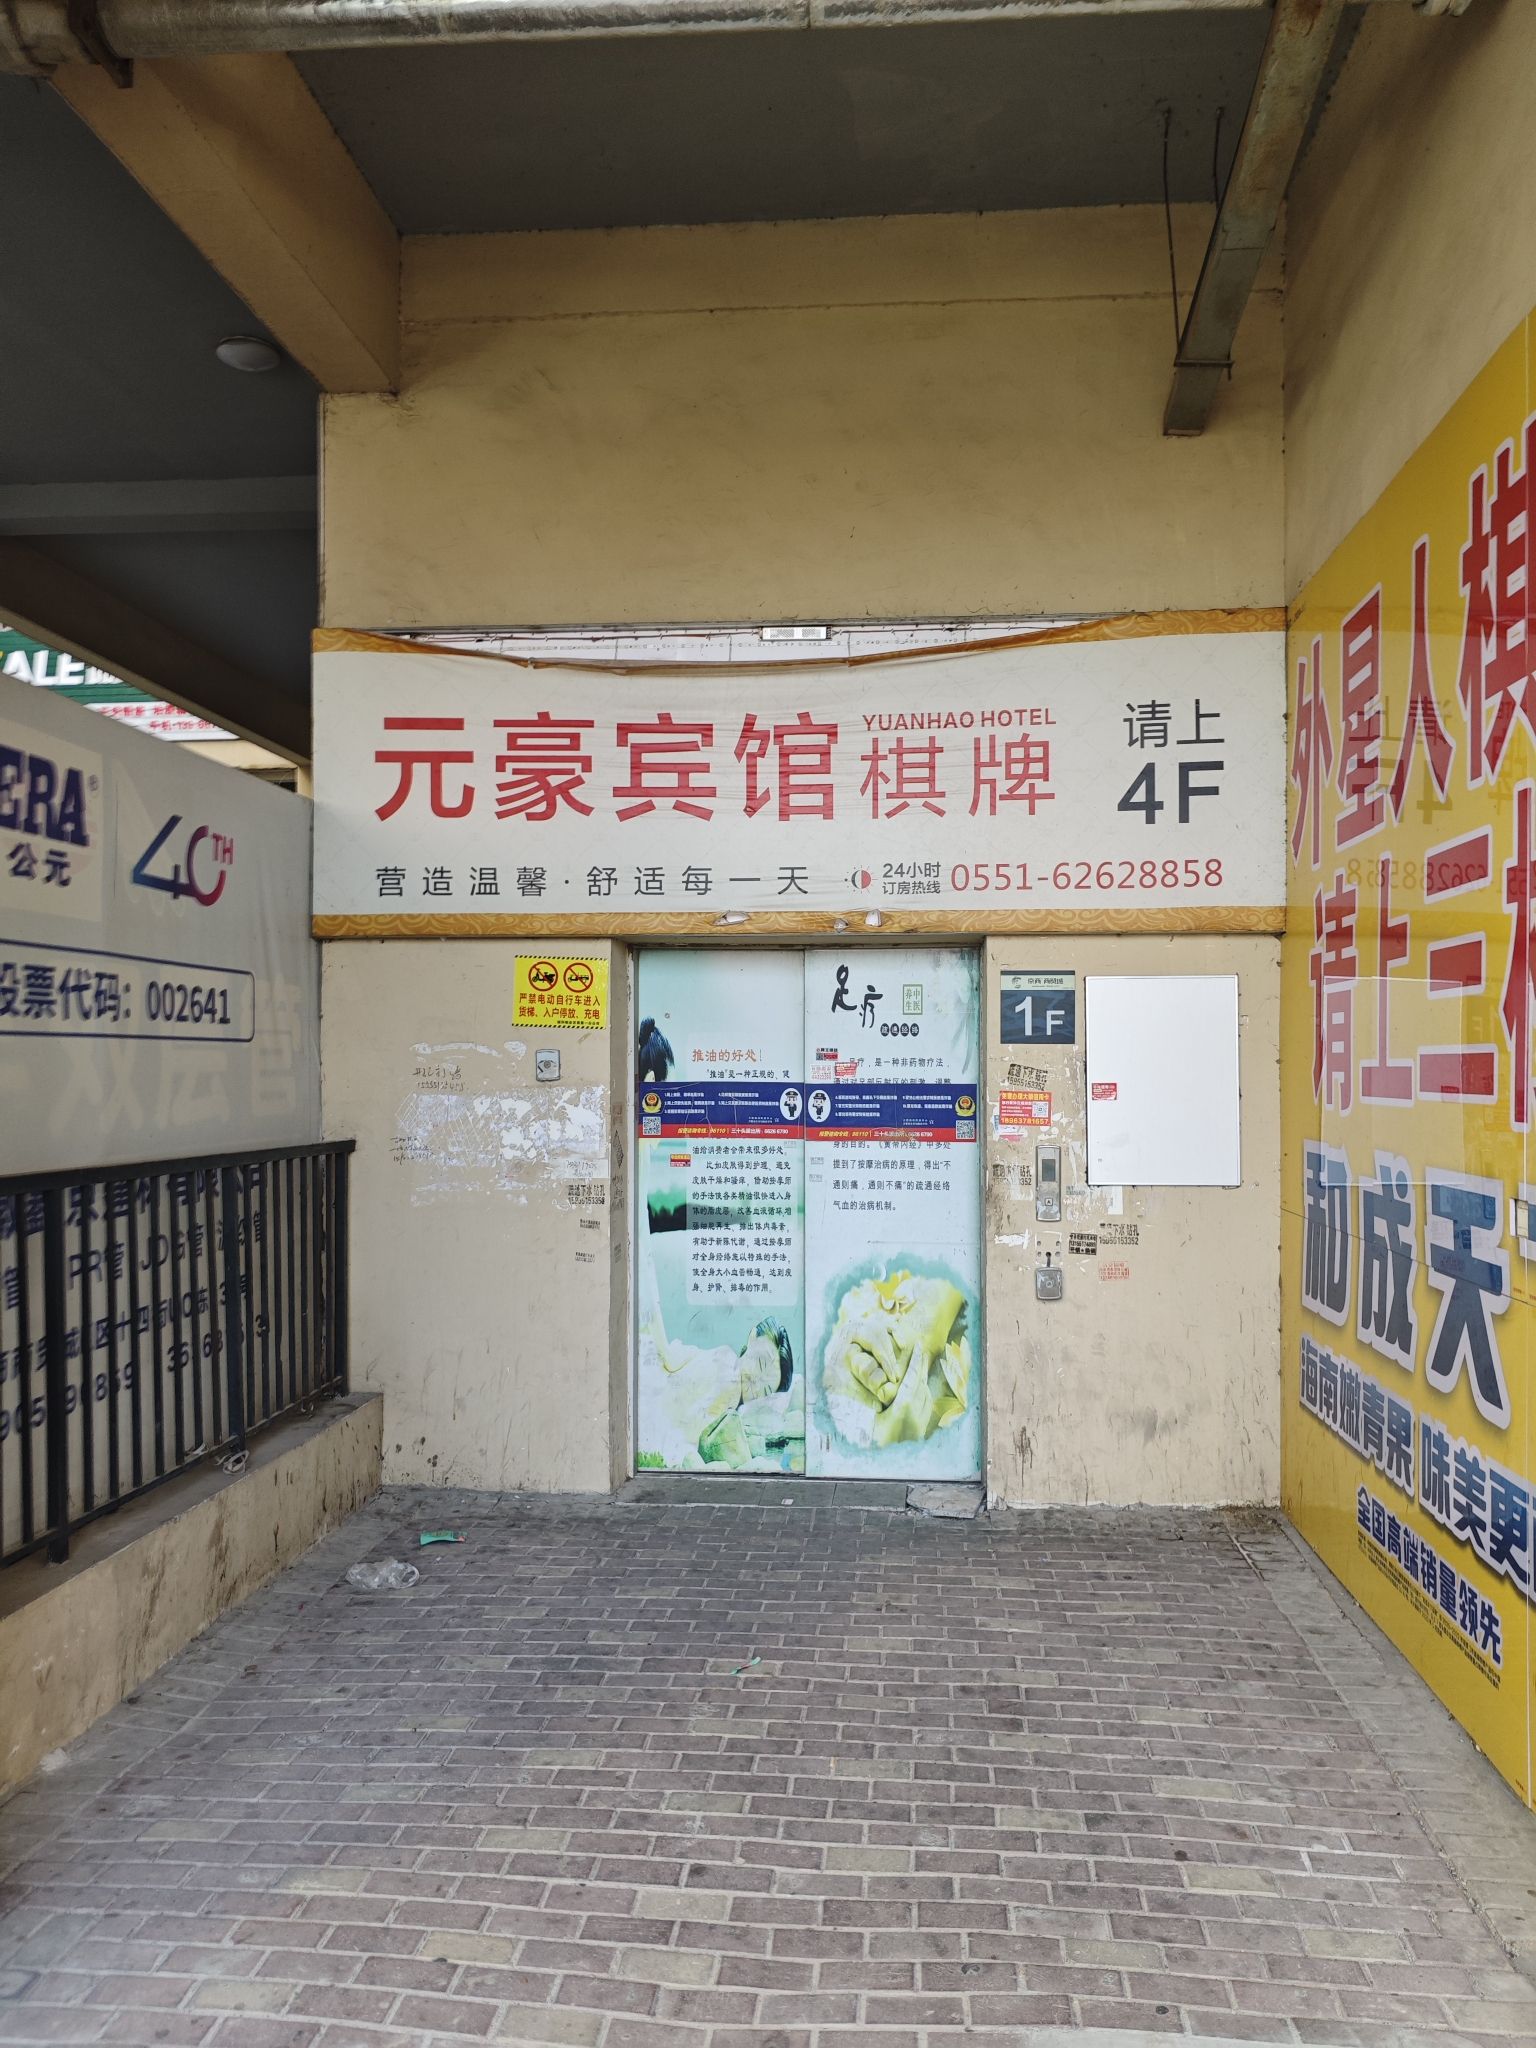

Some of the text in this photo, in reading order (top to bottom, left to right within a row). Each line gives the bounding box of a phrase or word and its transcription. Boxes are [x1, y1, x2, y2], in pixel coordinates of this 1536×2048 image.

[862, 707, 1056, 732] YUANHAO HOTEL
[1123, 698, 1225, 748] 请上
[374, 711, 838, 823] 元豪宾馆
[860, 733, 1056, 820] 棋牌
[0, 743, 90, 847] ERA
[1117, 760, 1225, 825] 4F
[6, 842, 72, 888] 公元
[376, 865, 808, 898] 营造温馨·舒适每一天
[882, 862, 942, 879] 24小时
[882, 880, 942, 896] 订房热线
[950, 857, 1223, 892] 0551-62628858
[518, 1007, 600, 1019] 货梯、入户停放、充电
[519, 993, 600, 1007] 严禁电动自行车进入
[833, 1200, 897, 1212] 气血的治病机制。
[1304, 1152, 1536, 1411] 和成天
[1421, 1421, 1536, 1592] 味美更
[1357, 1486, 1501, 1664] 全国高端销量领先
